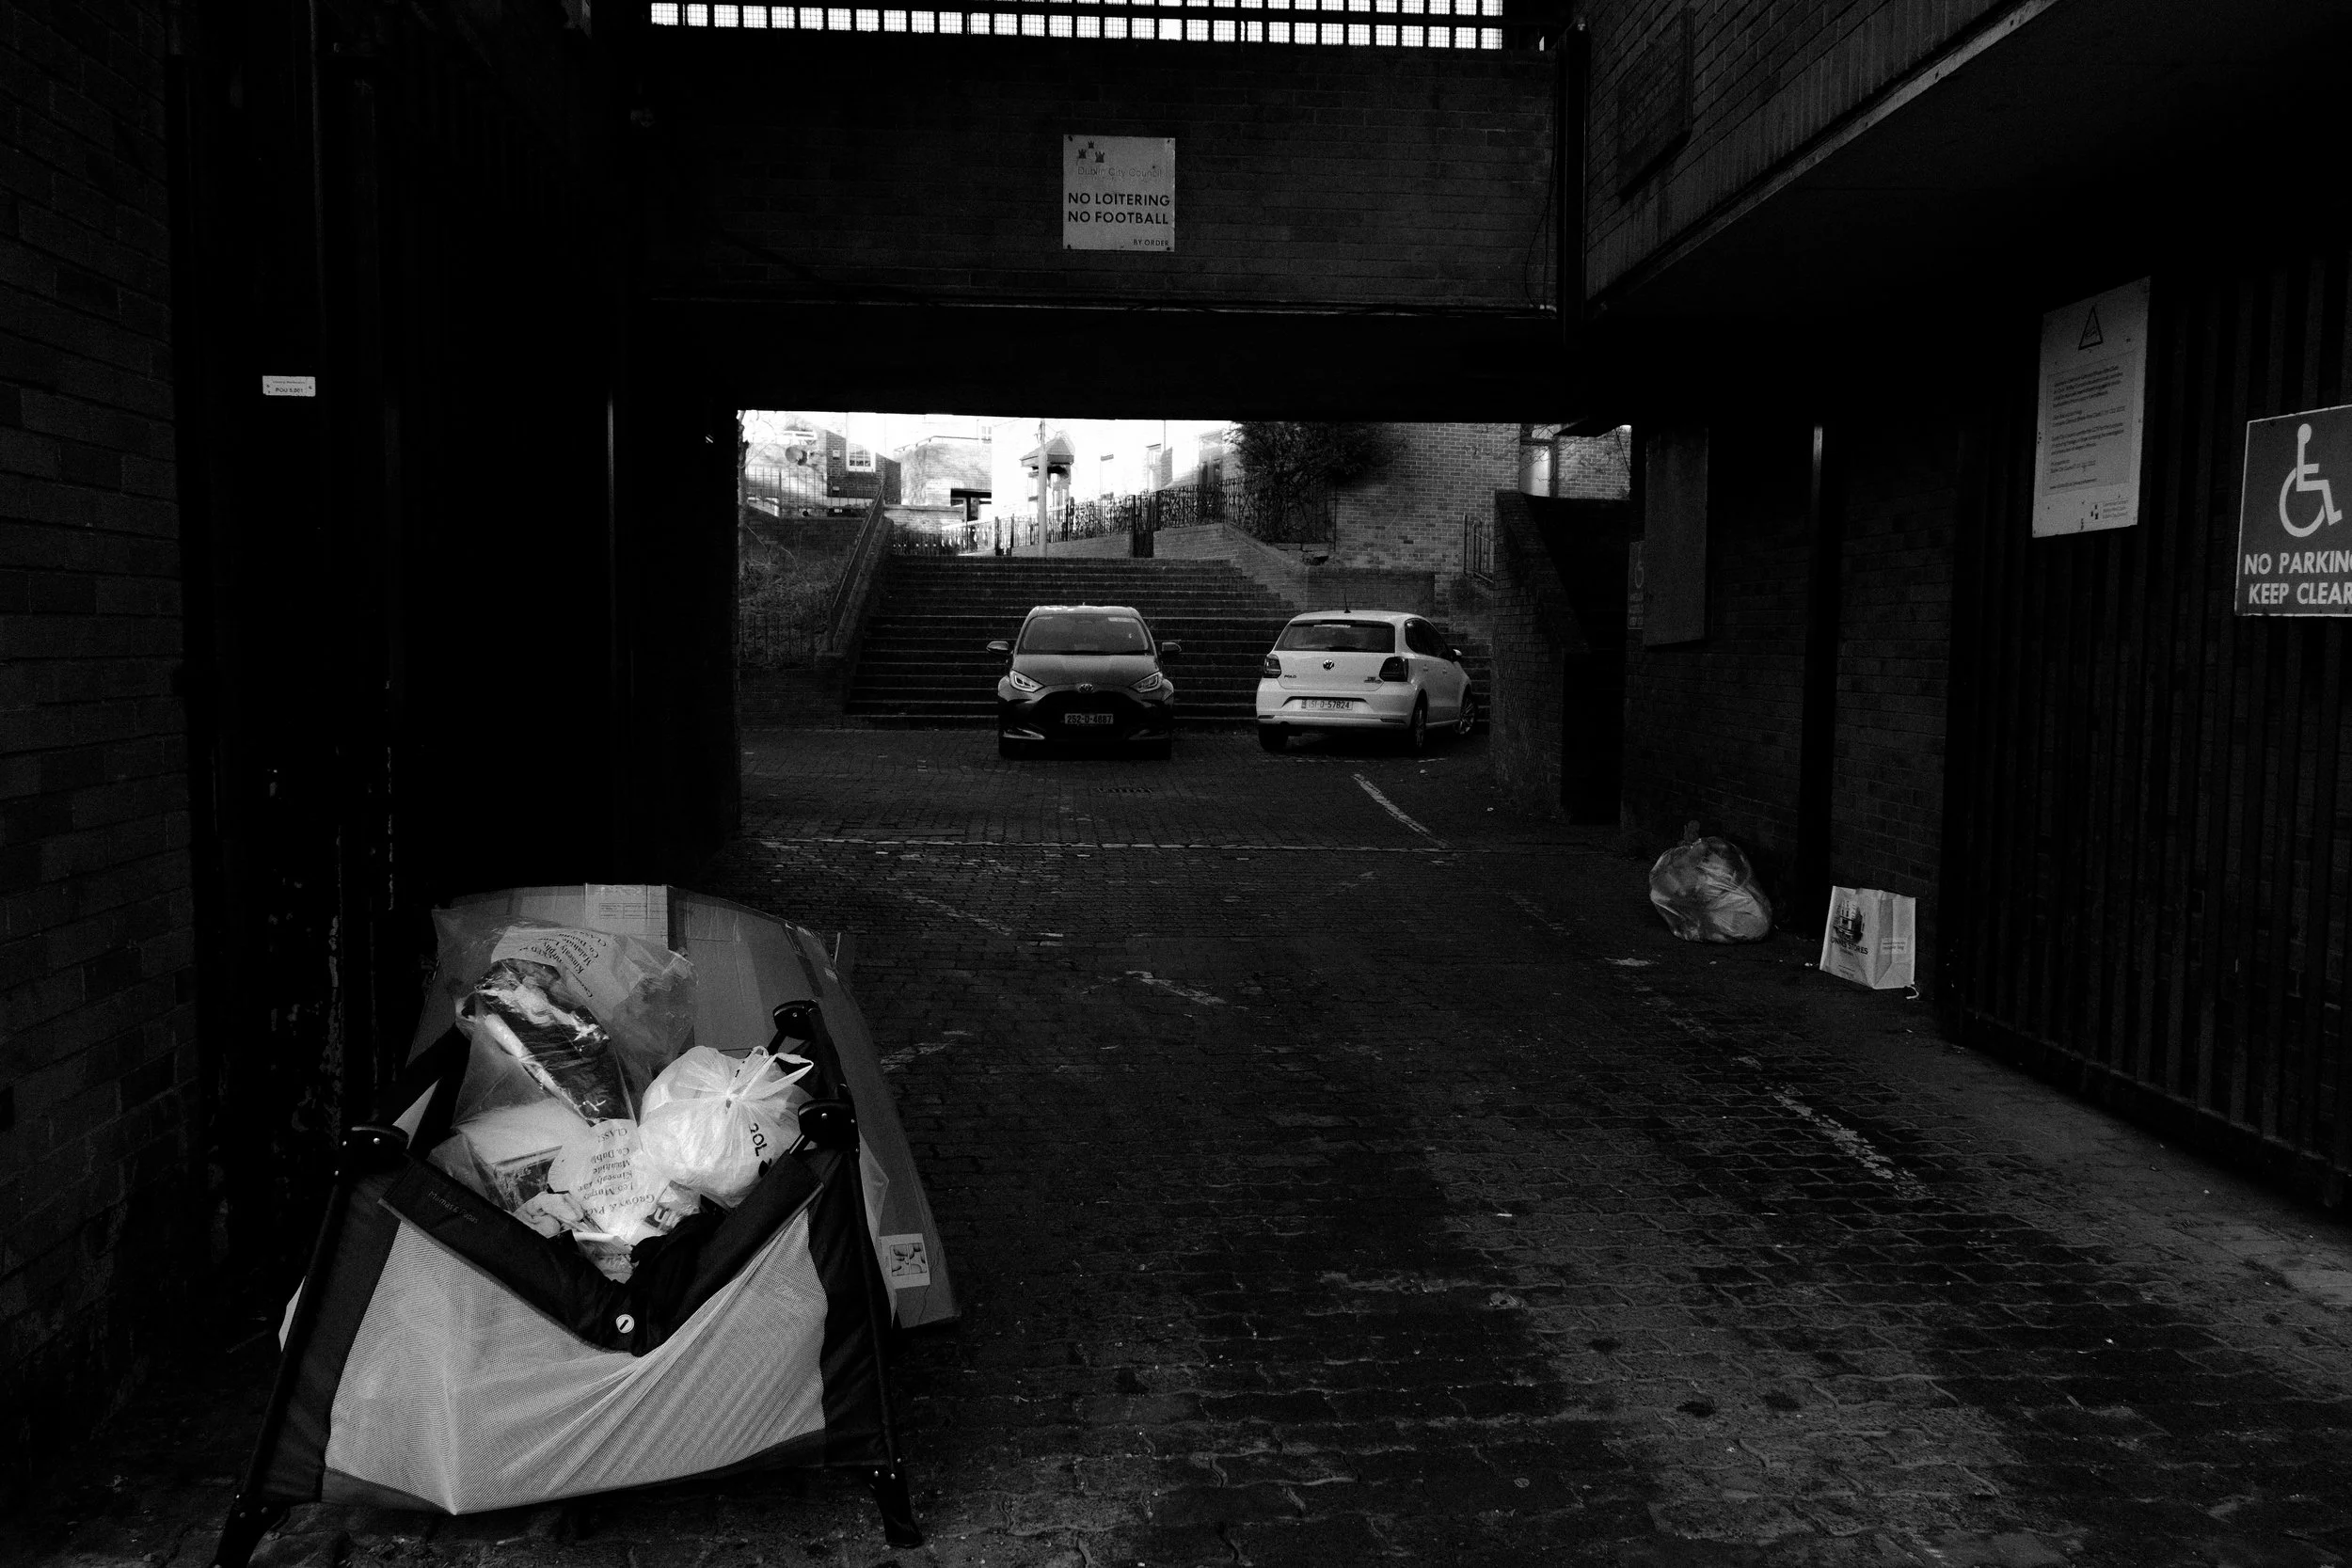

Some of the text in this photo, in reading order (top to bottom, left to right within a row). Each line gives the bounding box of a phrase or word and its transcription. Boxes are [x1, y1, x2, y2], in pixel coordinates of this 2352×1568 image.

[1078, 166, 1162, 178] Dublin City Council
[1068, 192, 1170, 206] NO LOITERING
[1068, 211, 1168, 224] NO FOOTBALL
[2244, 550, 2352, 575] NO PARKIN
[2248, 582, 2352, 604] KEEP CLEAR
